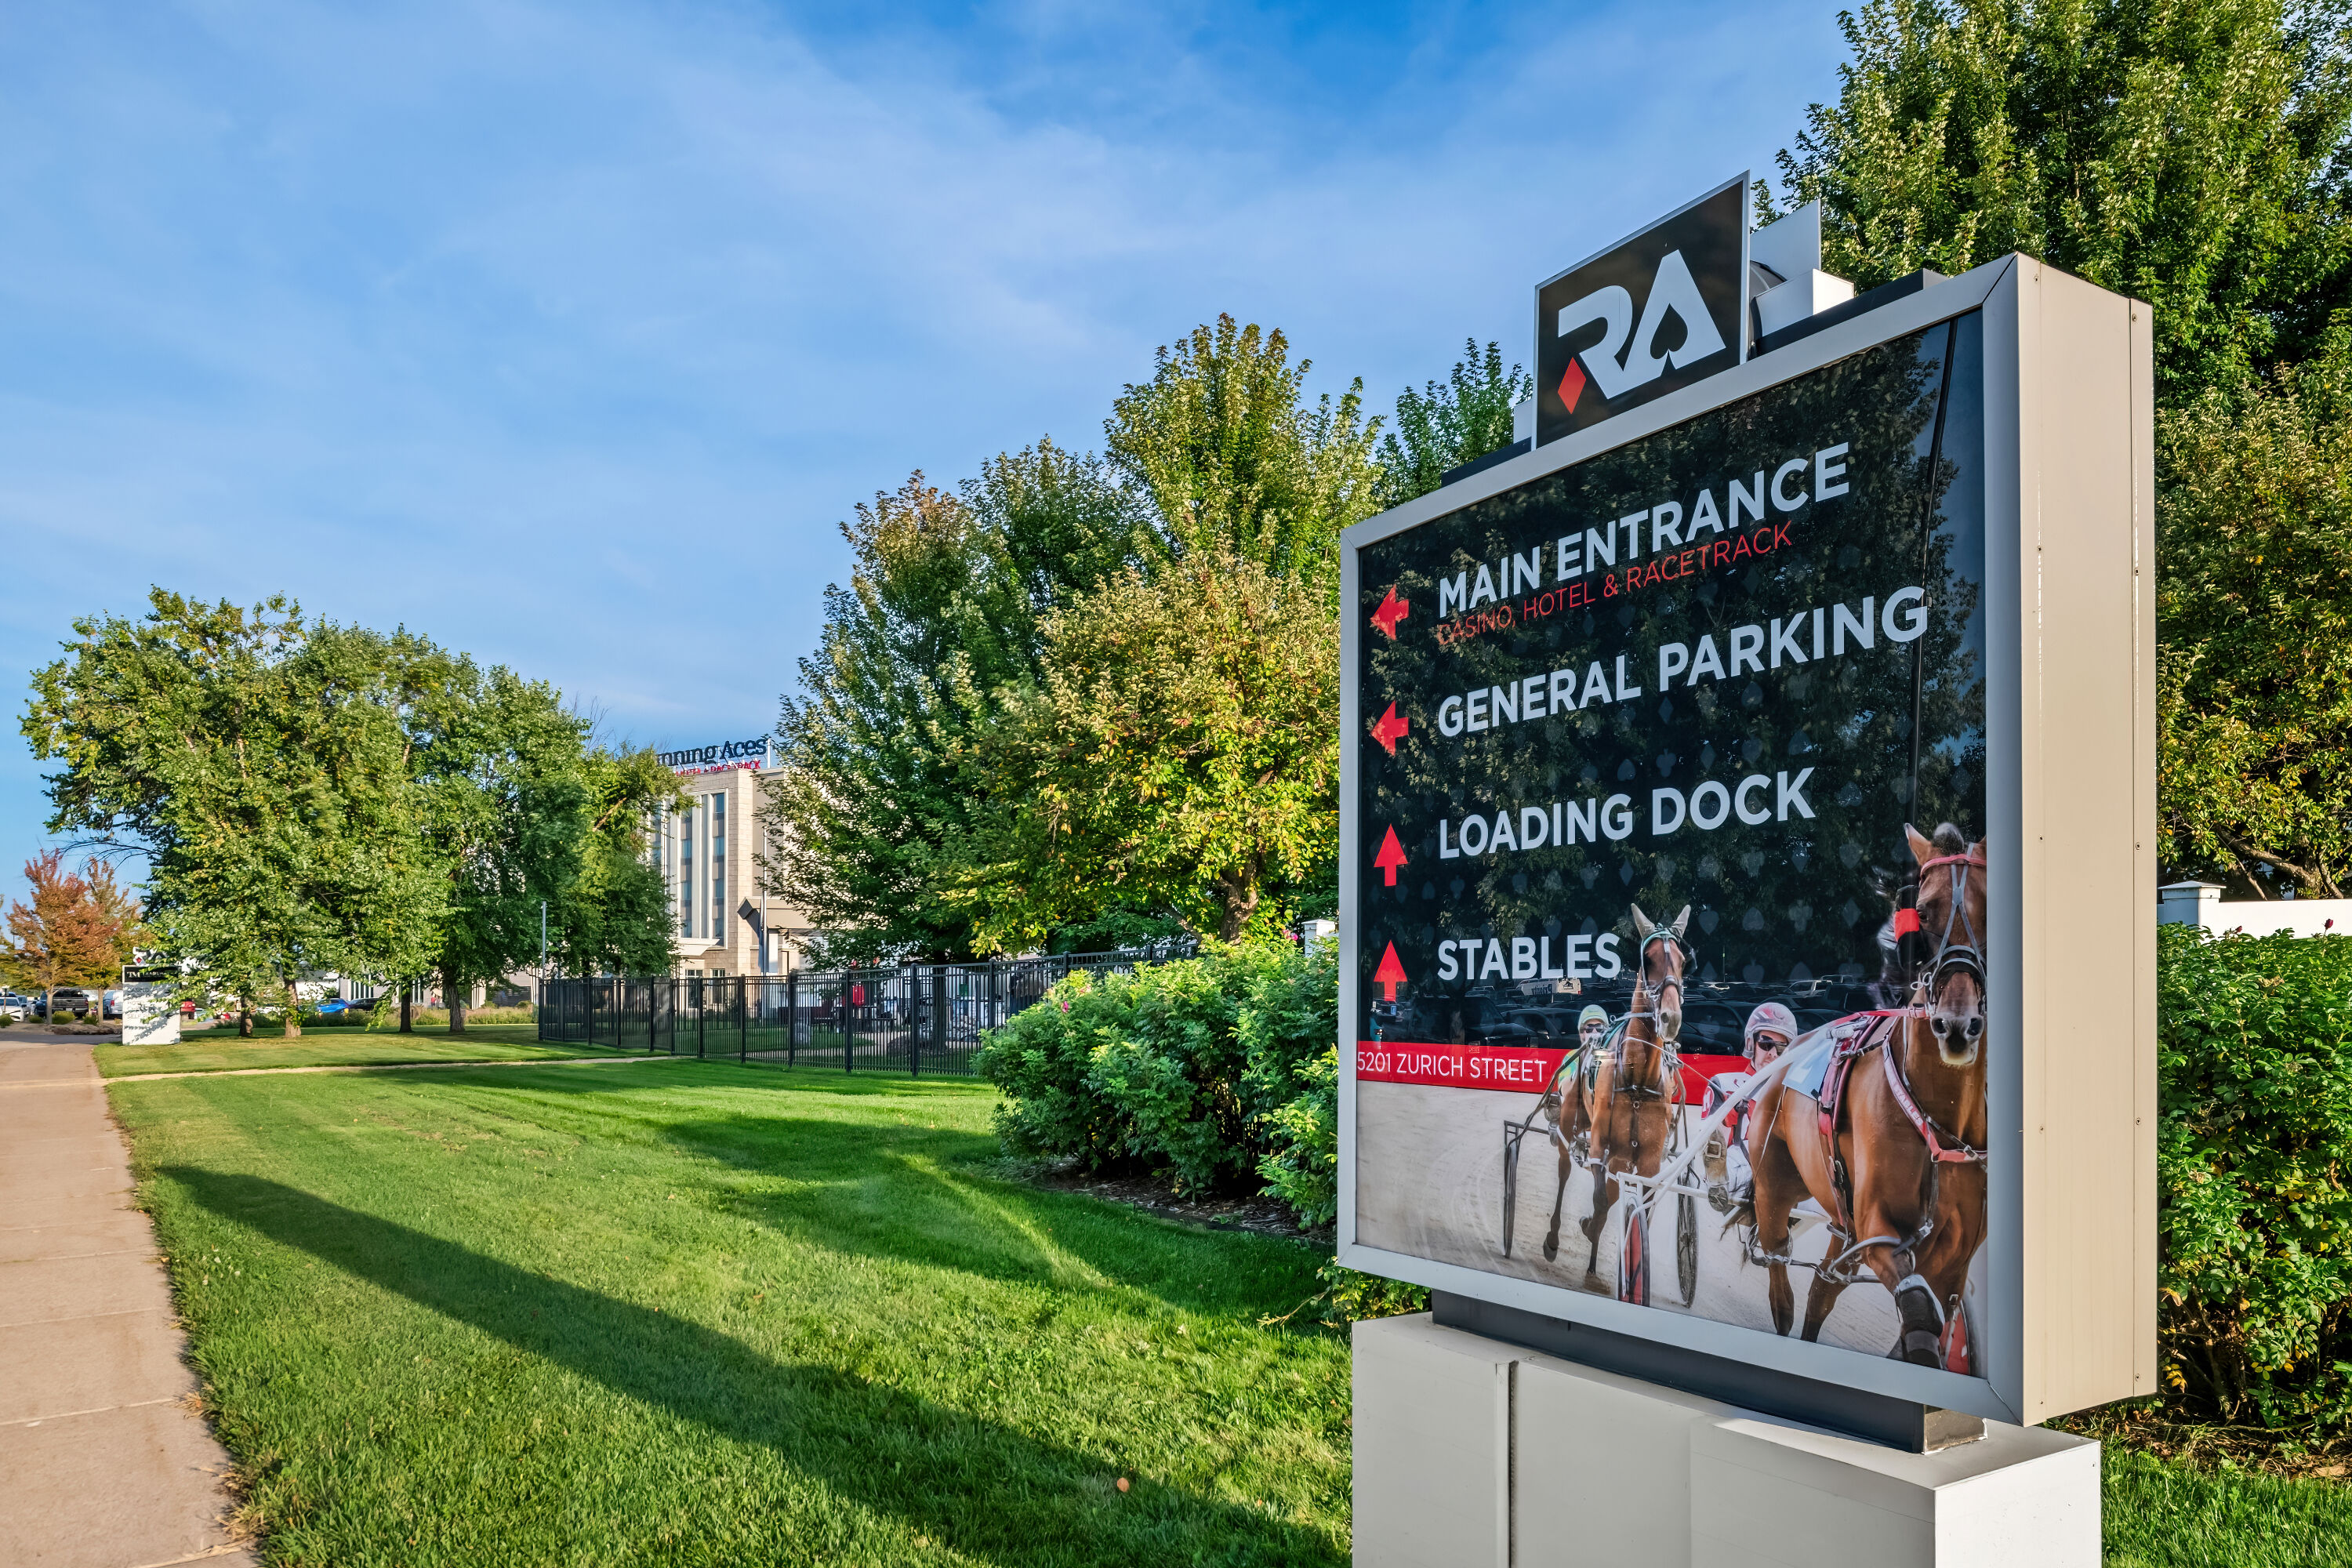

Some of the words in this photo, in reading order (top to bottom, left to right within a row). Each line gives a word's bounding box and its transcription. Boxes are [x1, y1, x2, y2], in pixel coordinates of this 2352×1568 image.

[1558, 249, 1726, 414] RA
[1439, 546, 1541, 619] MAIN
[1557, 441, 1849, 582] ENTRANCE
[1439, 605, 1515, 645] CASINO,
[1523, 582, 1596, 621] HOTEL
[1603, 573, 1620, 598] &
[1628, 521, 1792, 592] RACETRACK
[1439, 655, 1642, 738] GENERAL
[1660, 586, 1929, 692] PARKING
[720, 739, 767, 760] Aces
[1440, 793, 1633, 859] LOADING
[1652, 767, 1816, 836] DOCK
[1438, 933, 1622, 981] STABLES
[1357, 1051, 1391, 1073] 5201
[1396, 1053, 1464, 1077] ZURICH
[1469, 1057, 1548, 1083] STREET
